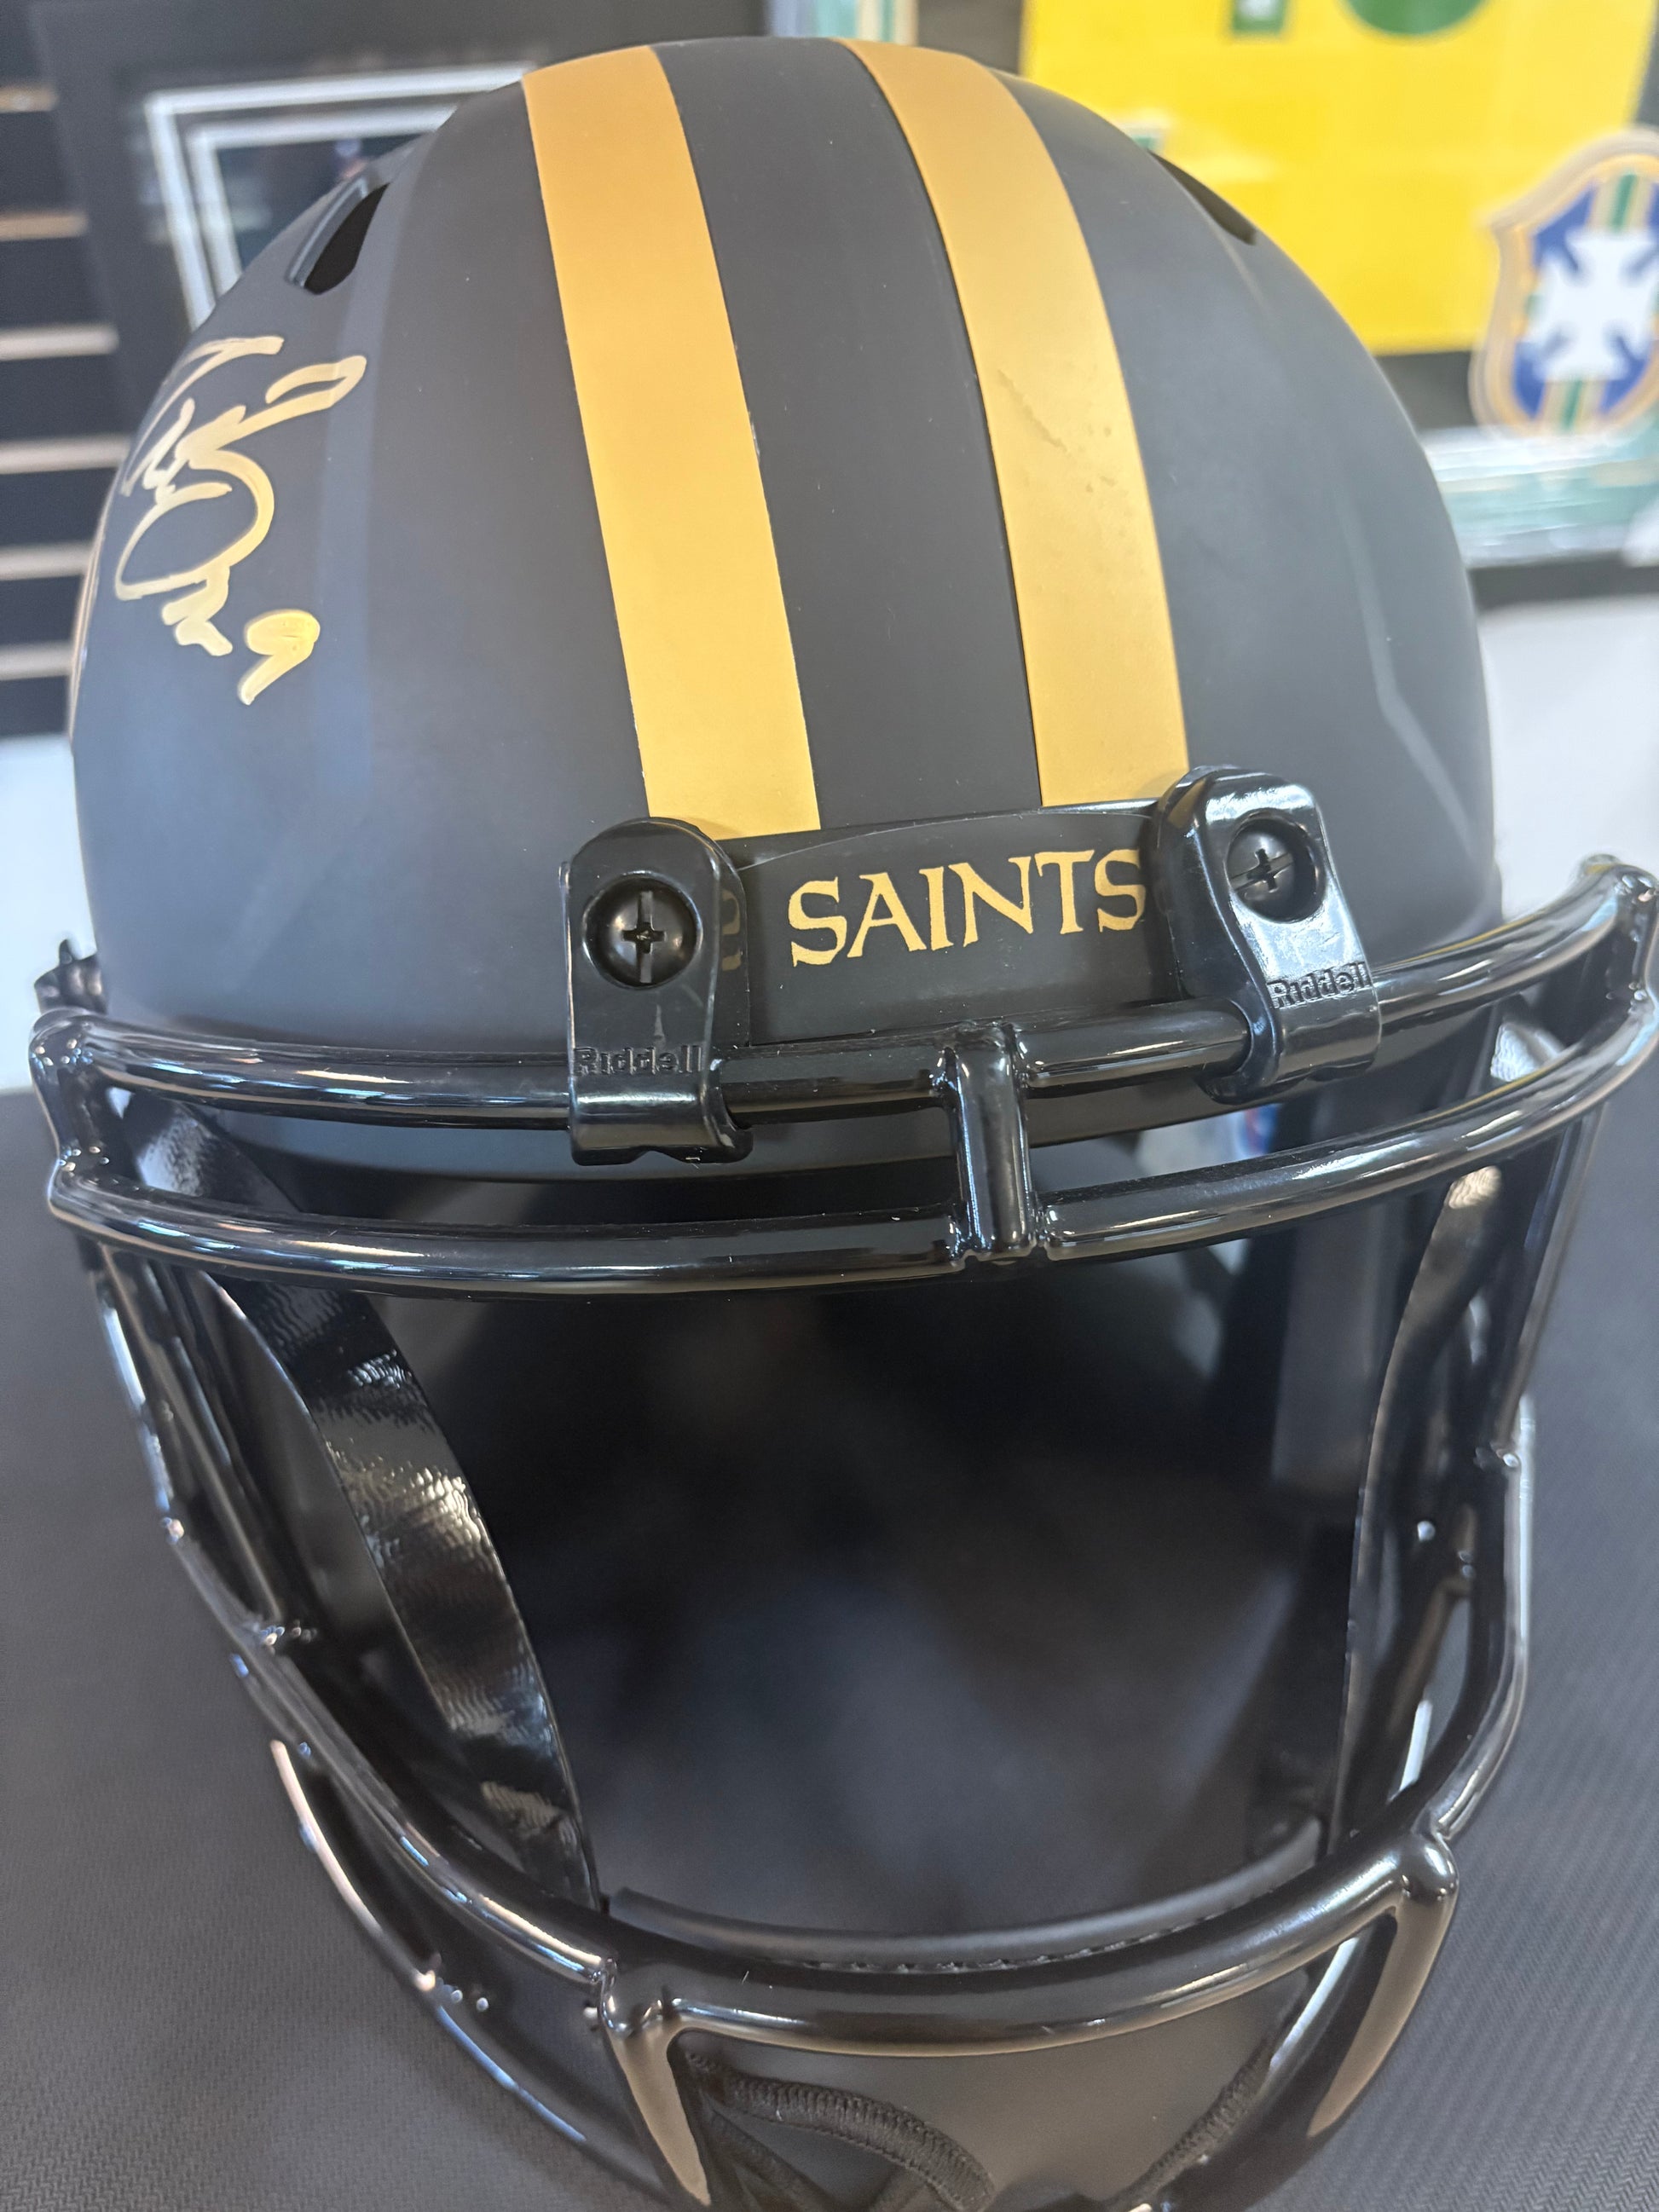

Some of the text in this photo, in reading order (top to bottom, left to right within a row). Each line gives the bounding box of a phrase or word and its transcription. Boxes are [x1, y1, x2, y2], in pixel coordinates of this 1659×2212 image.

[788, 849, 1147, 967] SAINTS
[1265, 960, 1373, 1010] Riddell
[574, 1044, 705, 1076] Riddell
